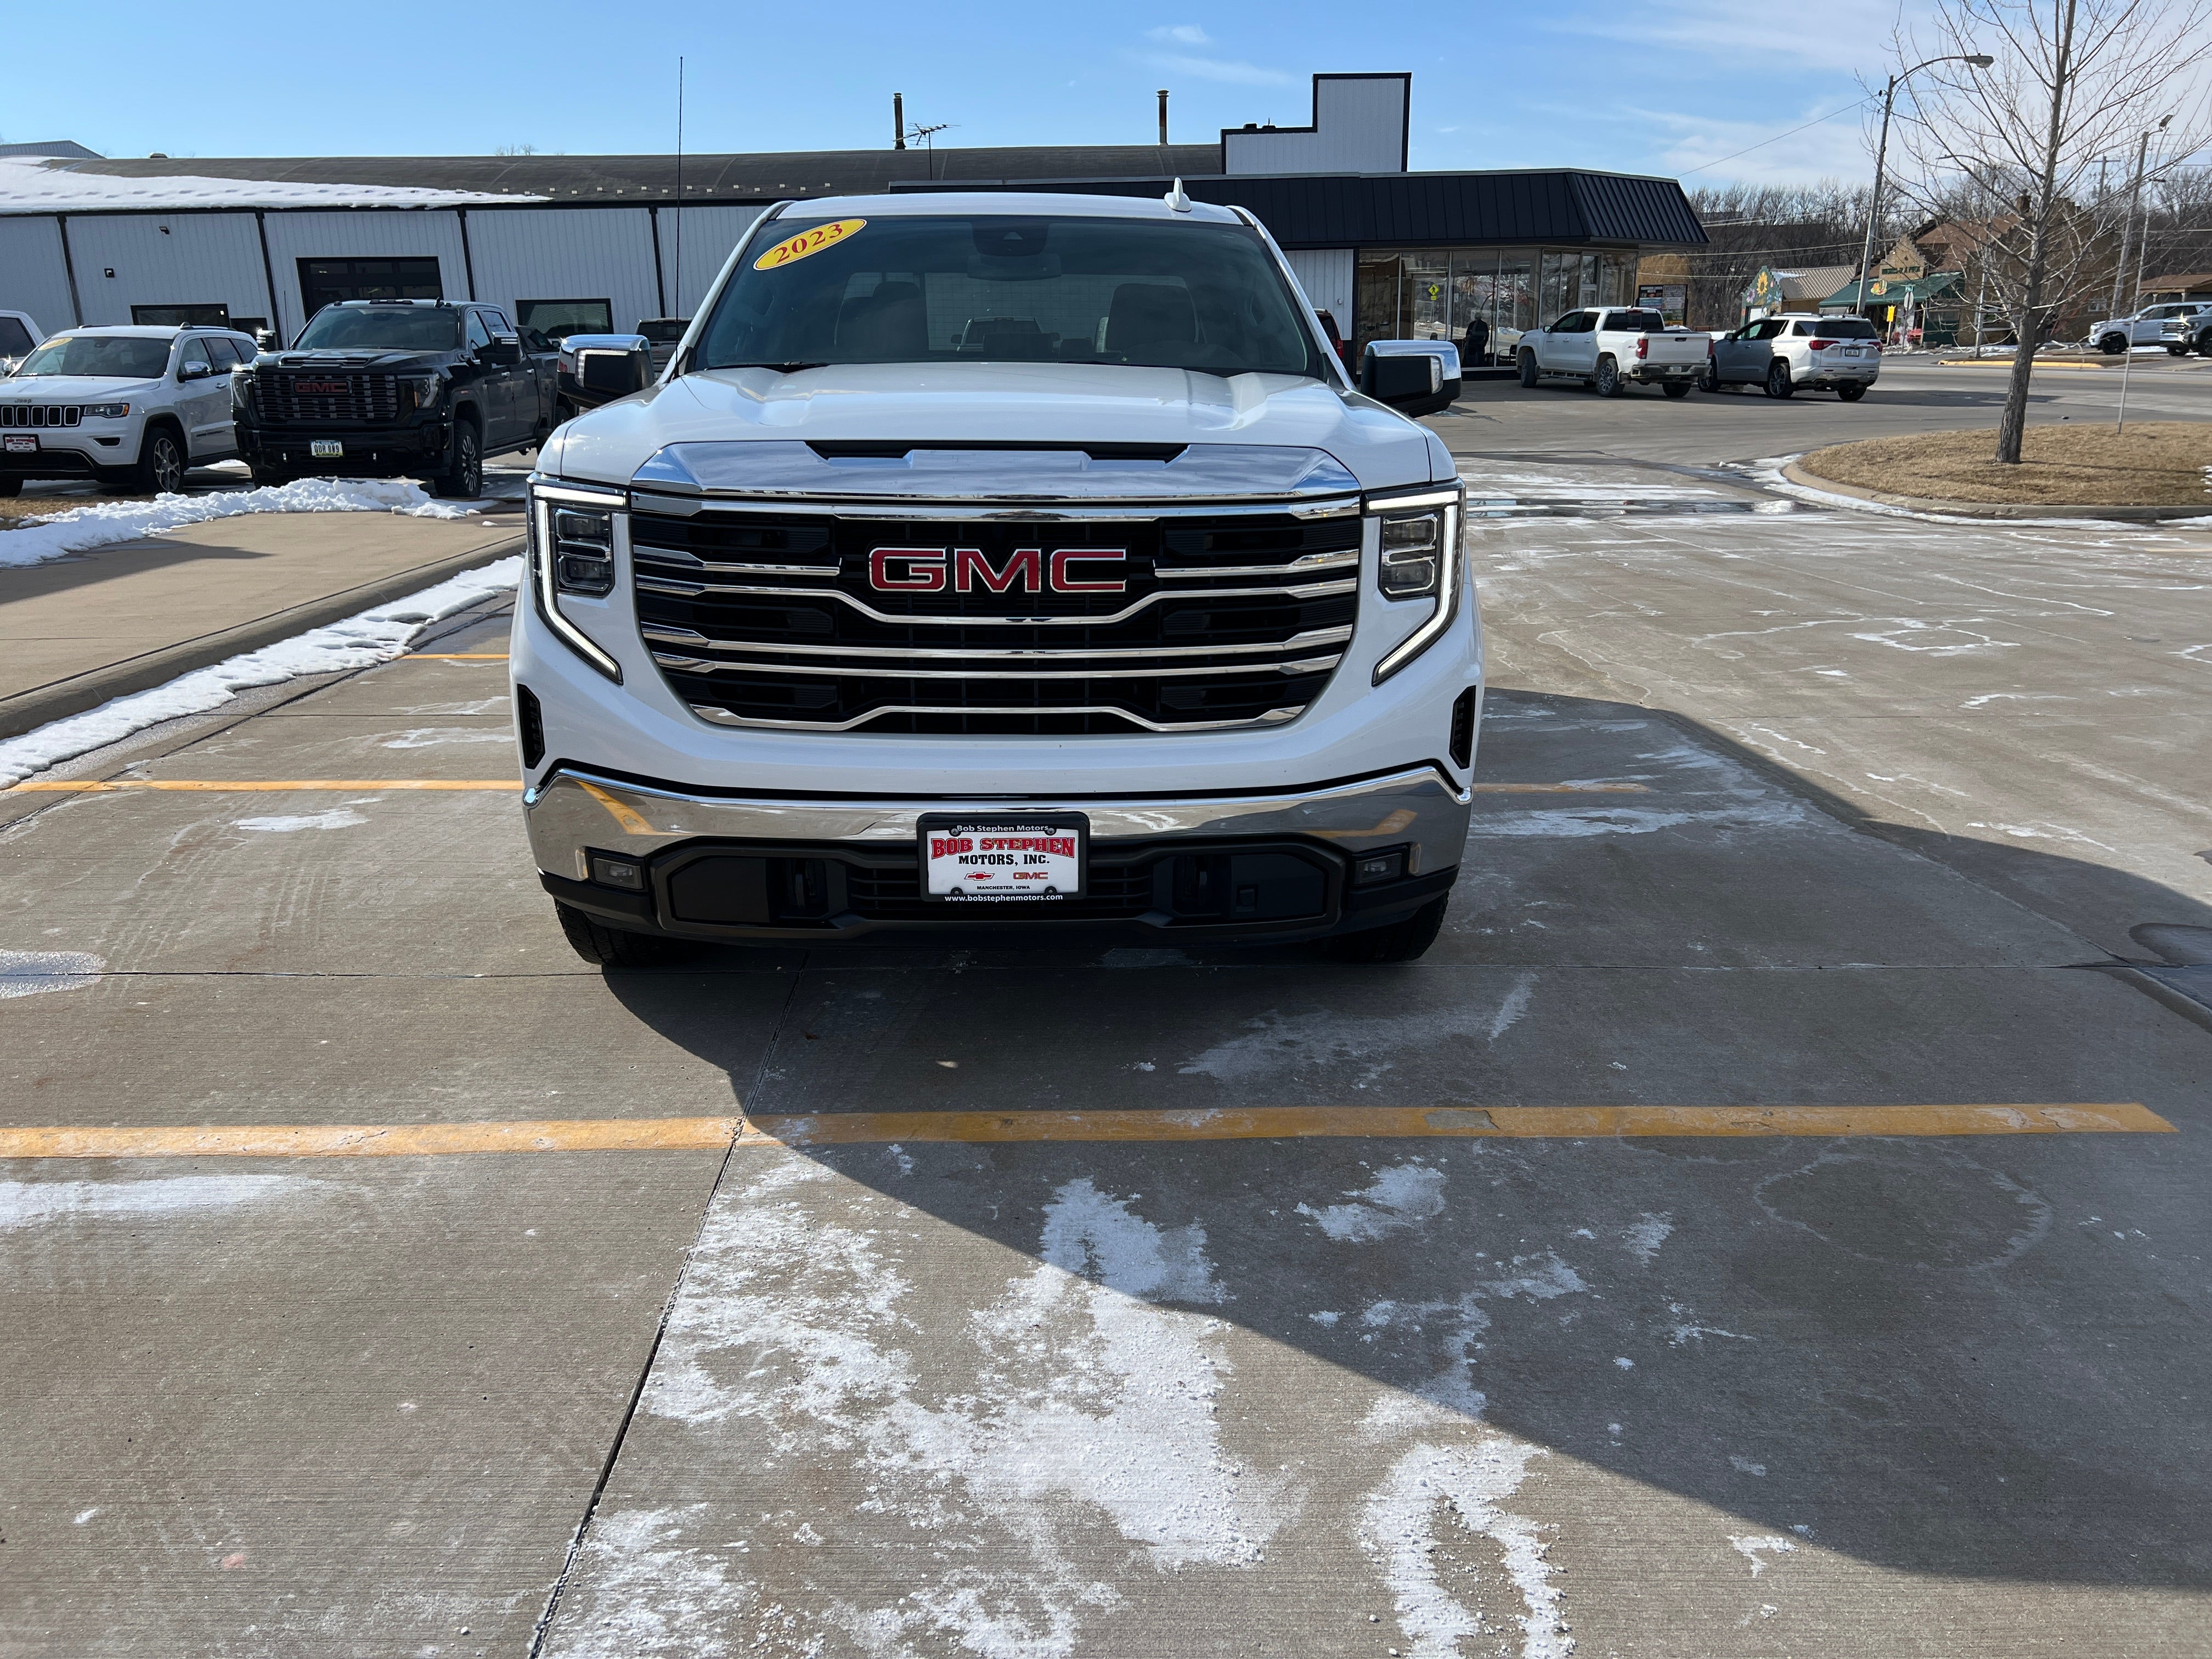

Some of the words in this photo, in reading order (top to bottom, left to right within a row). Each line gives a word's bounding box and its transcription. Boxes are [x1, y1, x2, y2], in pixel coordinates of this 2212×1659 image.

[774, 224, 843, 264] 2023
[295, 382, 347, 392] GMC
[869, 546, 1127, 593] GMC
[977, 825, 1014, 833] Stephen
[931, 837, 973, 859] BOB
[980, 837, 1075, 859] STEPHEN
[958, 854, 1018, 866] MOTORS,
[1024, 854, 1050, 865] INC.
[1013, 872, 1048, 880] GMC
[944, 894, 1063, 902] www.bobstephenmotors.com
